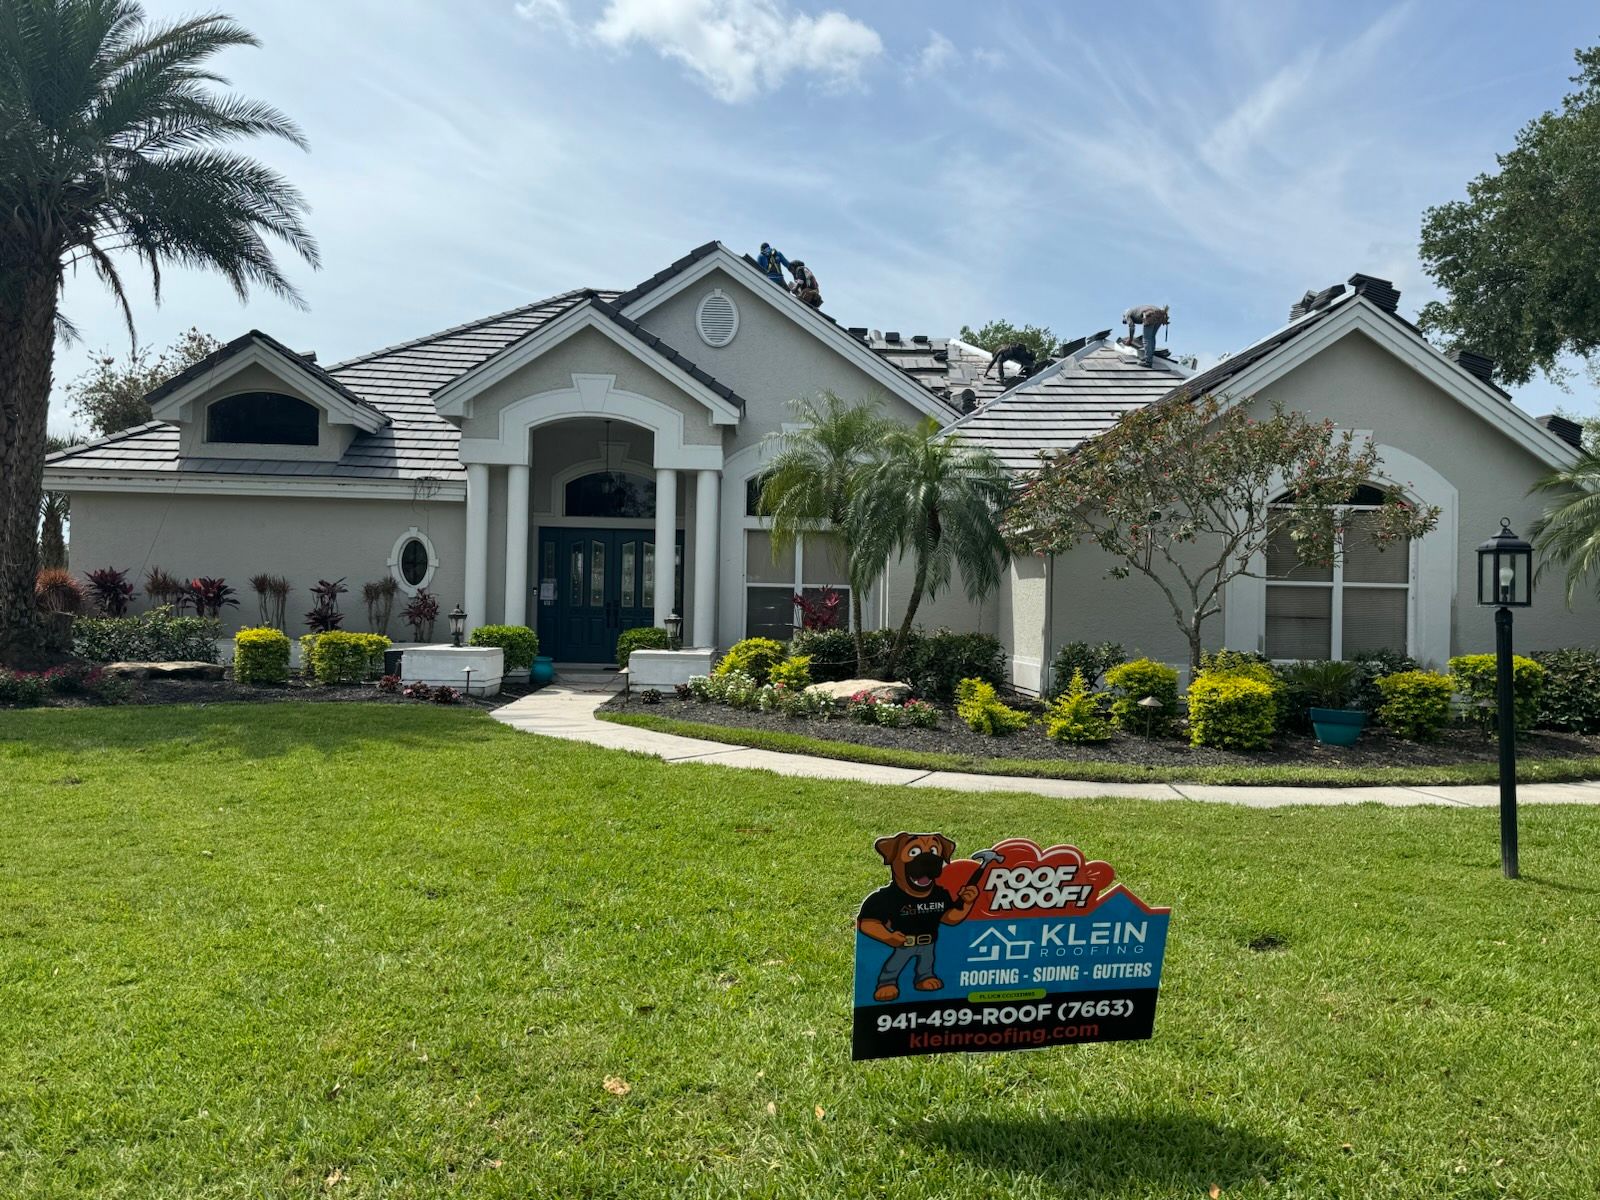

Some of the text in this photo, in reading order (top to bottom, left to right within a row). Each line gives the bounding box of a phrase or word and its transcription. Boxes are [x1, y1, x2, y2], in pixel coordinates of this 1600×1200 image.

[984, 865, 1077, 890] ROOF
[916, 901, 945, 911] KLEIN
[990, 885, 1092, 910] ROOF!
[1041, 921, 1148, 947] KLEIN
[1040, 945, 1144, 957] ROOFING
[960, 968, 1019, 986] ROOFING
[1033, 965, 1080, 983] SIDING
[1093, 962, 1152, 979] GUTTERS
[877, 999, 1134, 1032] 941-499-ROOF (7663)
[909, 1023, 1100, 1049] kleinroofing.com
